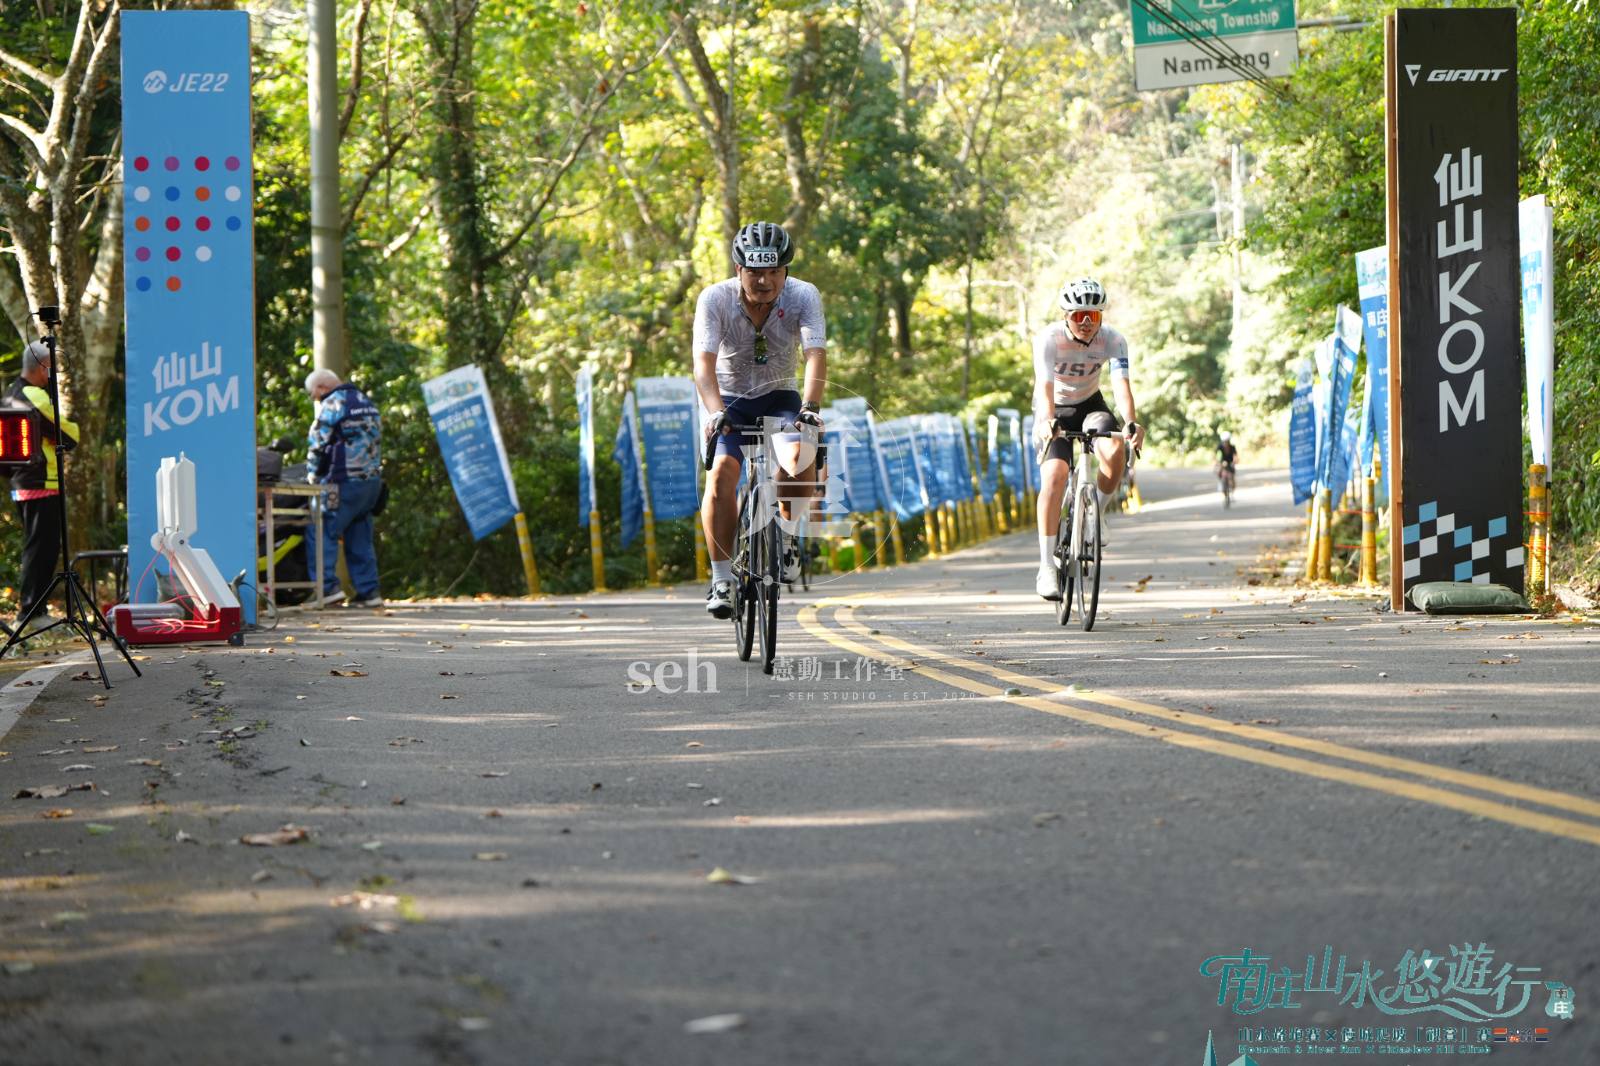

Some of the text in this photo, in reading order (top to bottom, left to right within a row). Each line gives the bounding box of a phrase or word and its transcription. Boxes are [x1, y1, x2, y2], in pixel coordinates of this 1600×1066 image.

[1221, 9, 1280, 28] Township
[1163, 51, 1271, 75] Namzong
[169, 73, 229, 93] JE22
[1427, 68, 1509, 82] GIANT
[152, 341, 222, 393] 仙山
[143, 376, 239, 437] KOM
